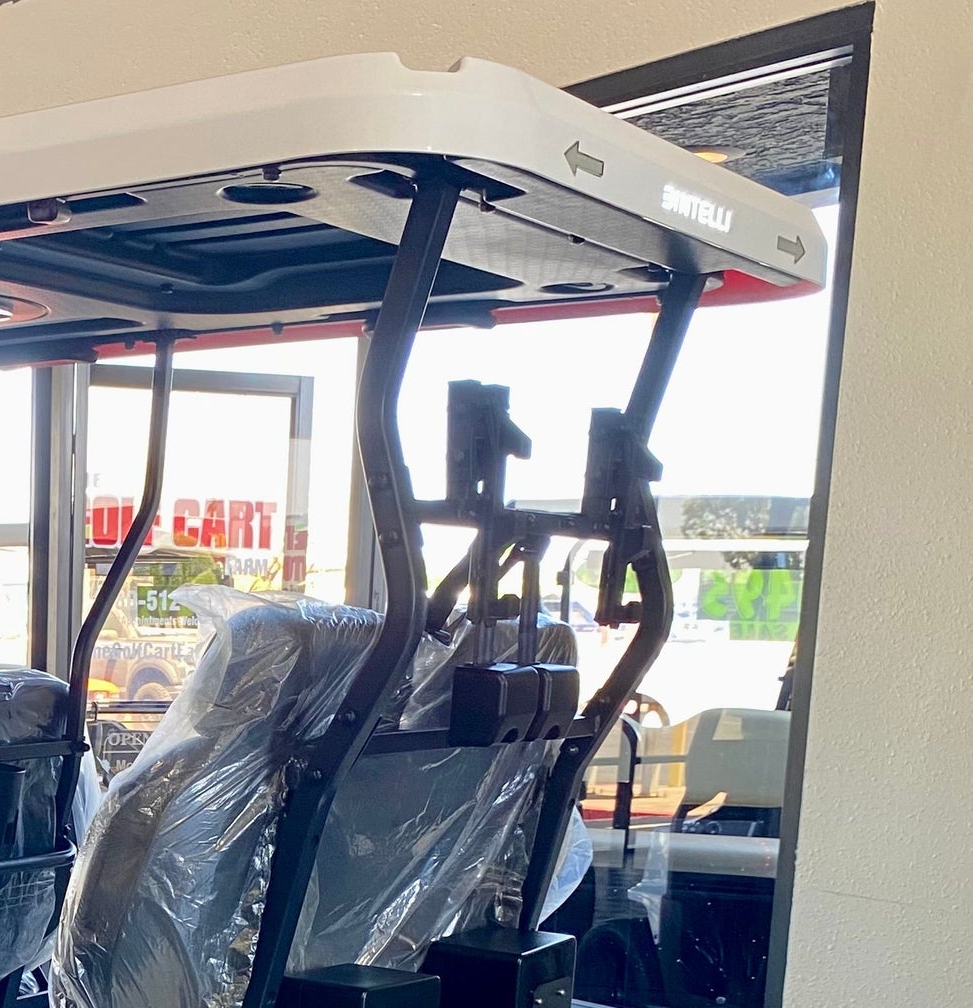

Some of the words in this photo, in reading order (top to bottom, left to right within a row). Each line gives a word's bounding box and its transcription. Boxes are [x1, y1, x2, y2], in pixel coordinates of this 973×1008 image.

[661, 184, 732, 233] BINTELLI
[85, 495, 162, 547] OL
[173, 498, 277, 549] CART
